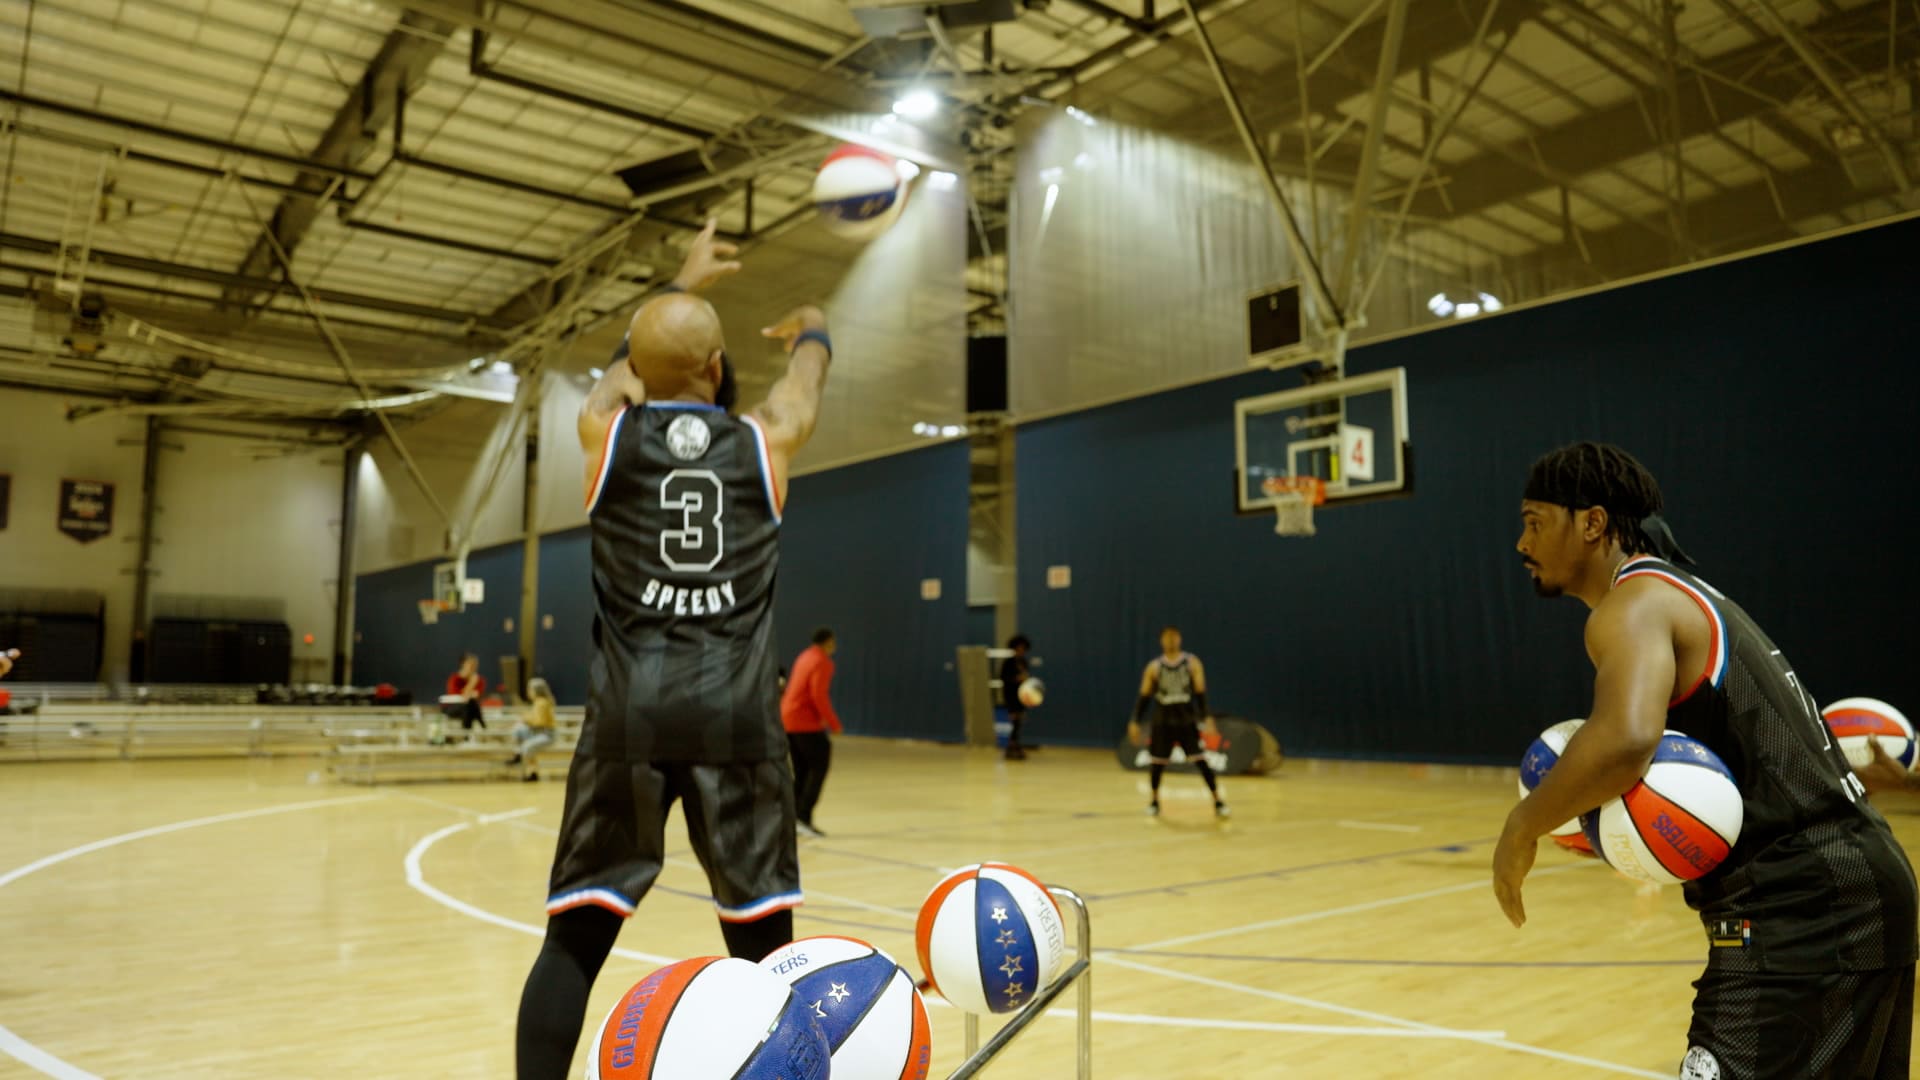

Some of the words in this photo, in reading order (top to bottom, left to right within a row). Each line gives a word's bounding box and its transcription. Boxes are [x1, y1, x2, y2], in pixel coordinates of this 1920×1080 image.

[1351, 437, 1365, 468] 4
[660, 469, 723, 572] 3
[641, 579, 736, 616] SPEEDY
